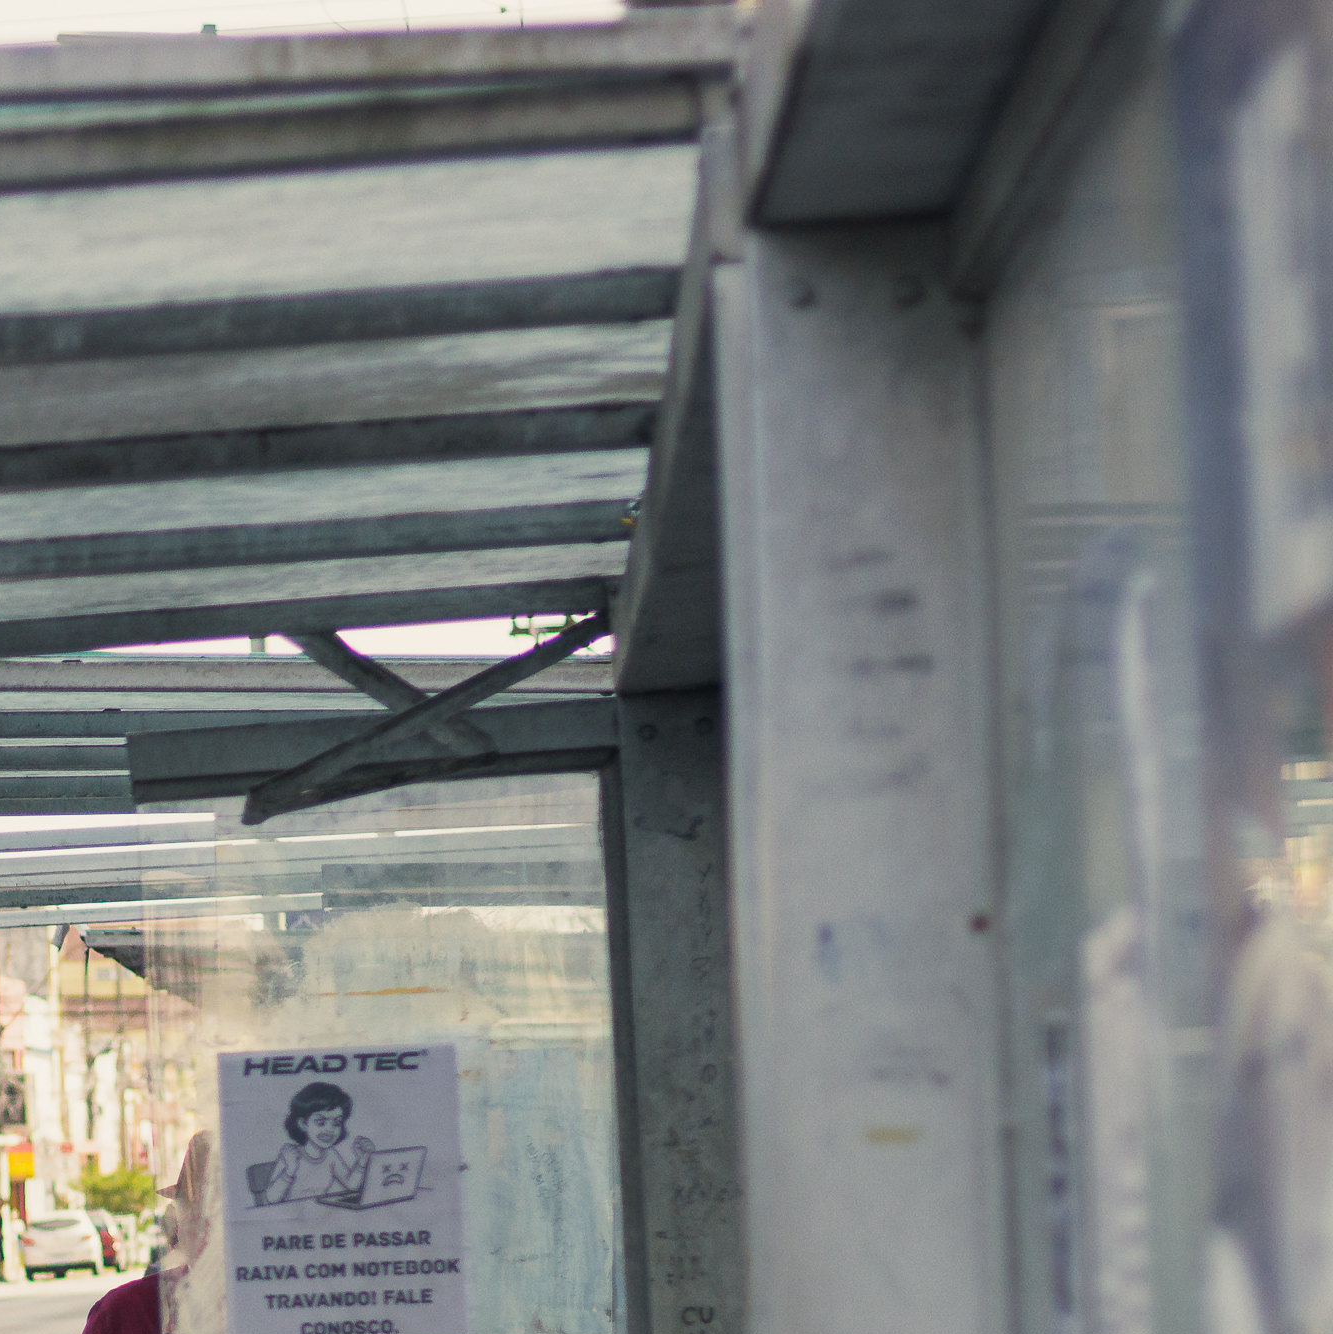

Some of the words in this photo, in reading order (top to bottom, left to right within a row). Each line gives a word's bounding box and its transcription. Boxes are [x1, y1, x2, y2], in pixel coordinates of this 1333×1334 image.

[243, 1053, 348, 1076] HEAD
[353, 1051, 420, 1072] TEC
[262, 1234, 315, 1250] PARE
[321, 1233, 347, 1249] DE
[353, 1230, 431, 1247] PASSAR
[236, 1265, 299, 1281] RAIVA
[304, 1262, 347, 1279] COM
[353, 1258, 461, 1277] NOTEBOOK
[265, 1290, 377, 1309] TRAVANDO!
[383, 1288, 434, 1305] FALE
